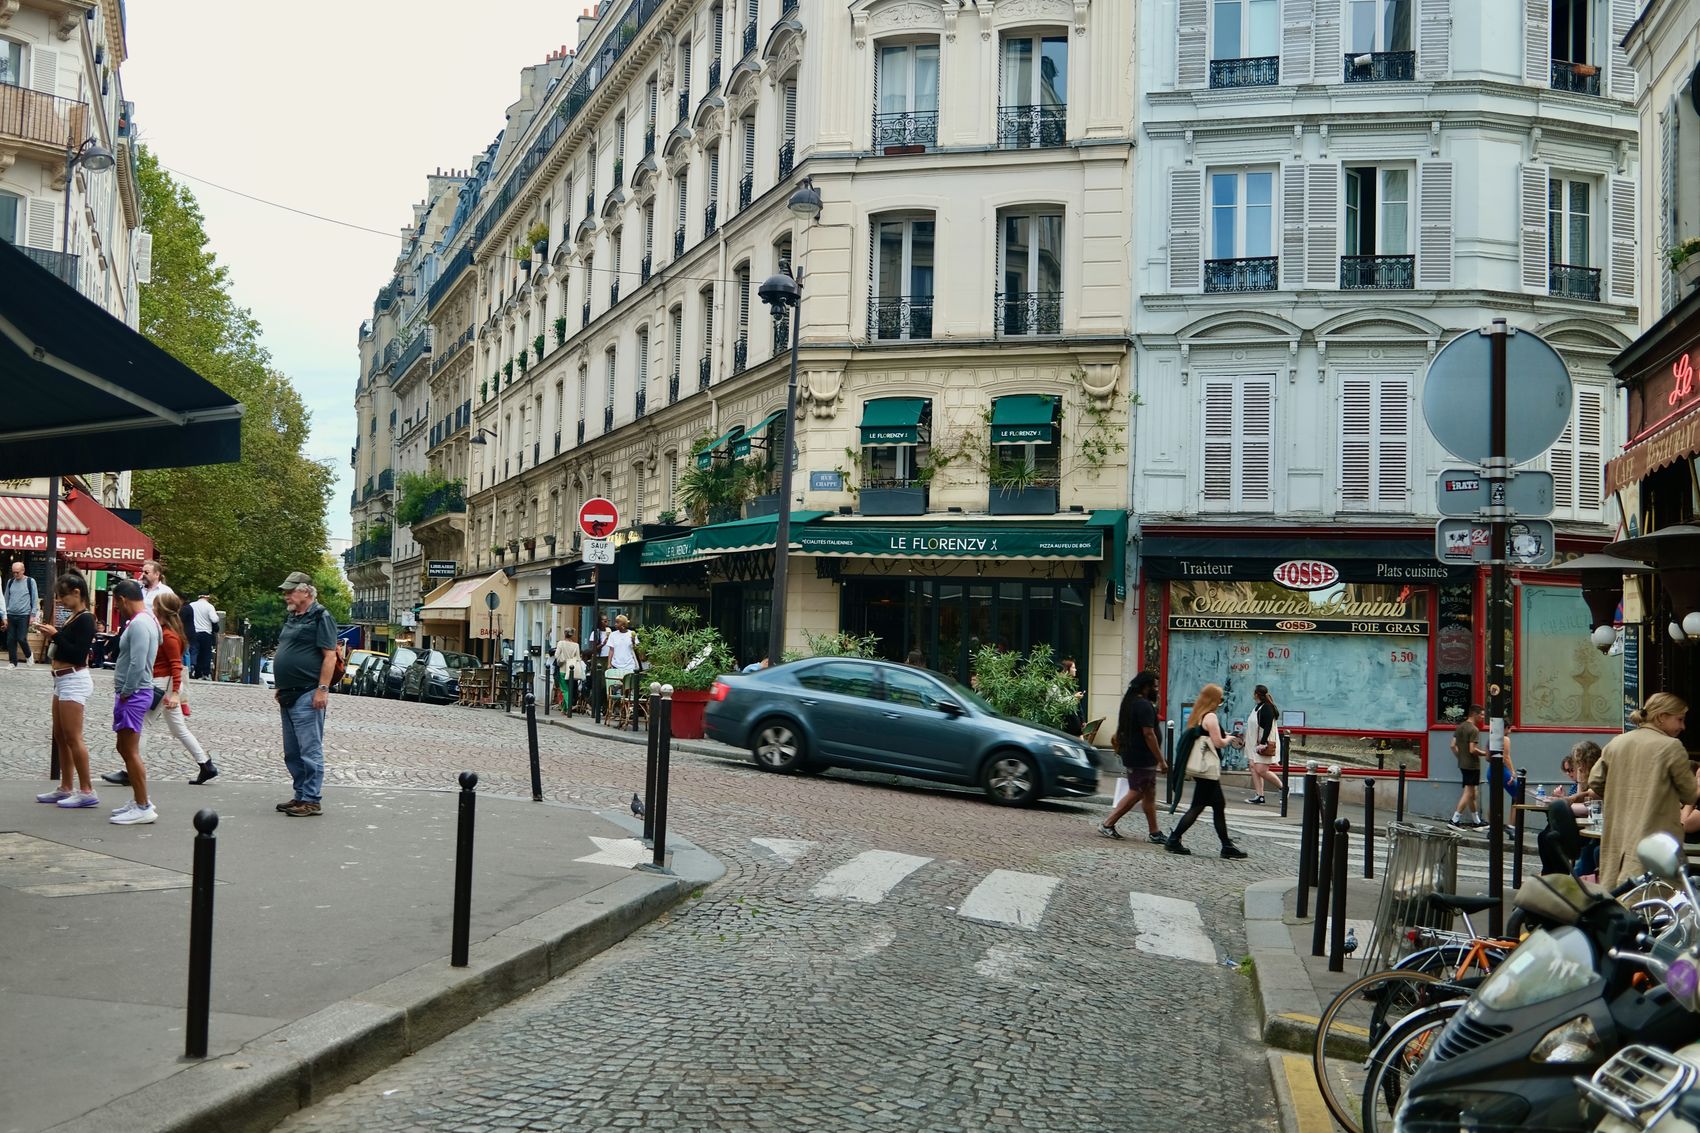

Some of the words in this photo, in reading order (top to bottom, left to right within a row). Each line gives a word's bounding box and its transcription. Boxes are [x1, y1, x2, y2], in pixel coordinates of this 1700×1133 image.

[1669, 353, 1692, 405] Le
[1647, 420, 1699, 470] RESTAURANT
[0, 534, 66, 549] CHAPE
[890, 537, 907, 549] LE
[1180, 561, 1233, 575] Traiteur
[1276, 562, 1334, 585] JOSSE
[1376, 563, 1403, 577] Plats
[1193, 586, 1312, 615] Sandwiches
[1320, 590, 1407, 617] Paninis
[1175, 618, 1248, 629] CHARCUTIER
[1278, 621, 1315, 630] JOSSE
[1351, 622, 1380, 632] FOIE
[1385, 623, 1420, 633] GRAS
[1268, 648, 1290, 659] 6.70
[1391, 651, 1414, 663] 5.50
